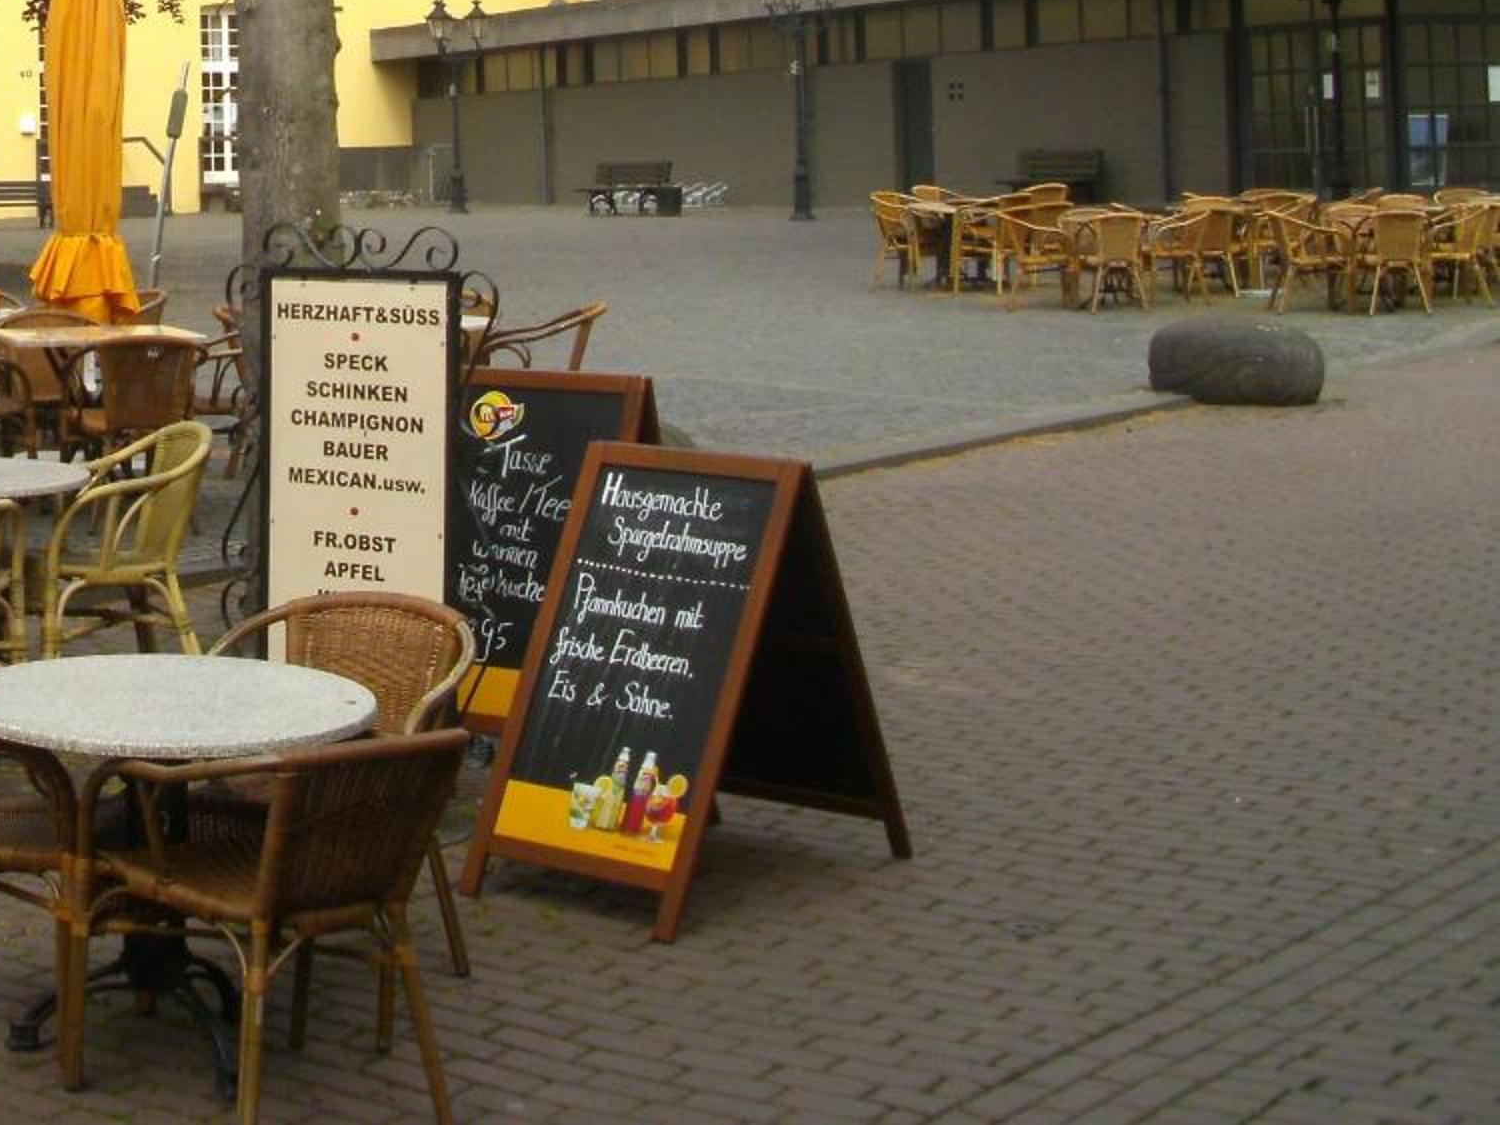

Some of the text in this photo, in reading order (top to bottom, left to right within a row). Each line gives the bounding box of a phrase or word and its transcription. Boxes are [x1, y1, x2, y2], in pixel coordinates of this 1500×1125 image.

[277, 303, 440, 326] HERZHAFT&SÜSS
[324, 352, 388, 372] SPECK
[306, 381, 408, 403] SCHINKEN
[291, 409, 424, 434] CHAMPIGNON
[323, 441, 388, 461] BAUER
[484, 434, 552, 478] Tasse
[288, 467, 426, 495] MEXICAN.usw.
[601, 471, 724, 522] Hausgemachte
[313, 531, 396, 554] FR.OBST
[499, 518, 534, 543] mit
[607, 516, 749, 570] Spargelrahmsuppe
[324, 561, 385, 582] APFEL
[573, 572, 706, 630] Pfannkuchen mit
[549, 626, 606, 665] frische
[547, 670, 577, 703] Eis
[585, 682, 610, 707] &
